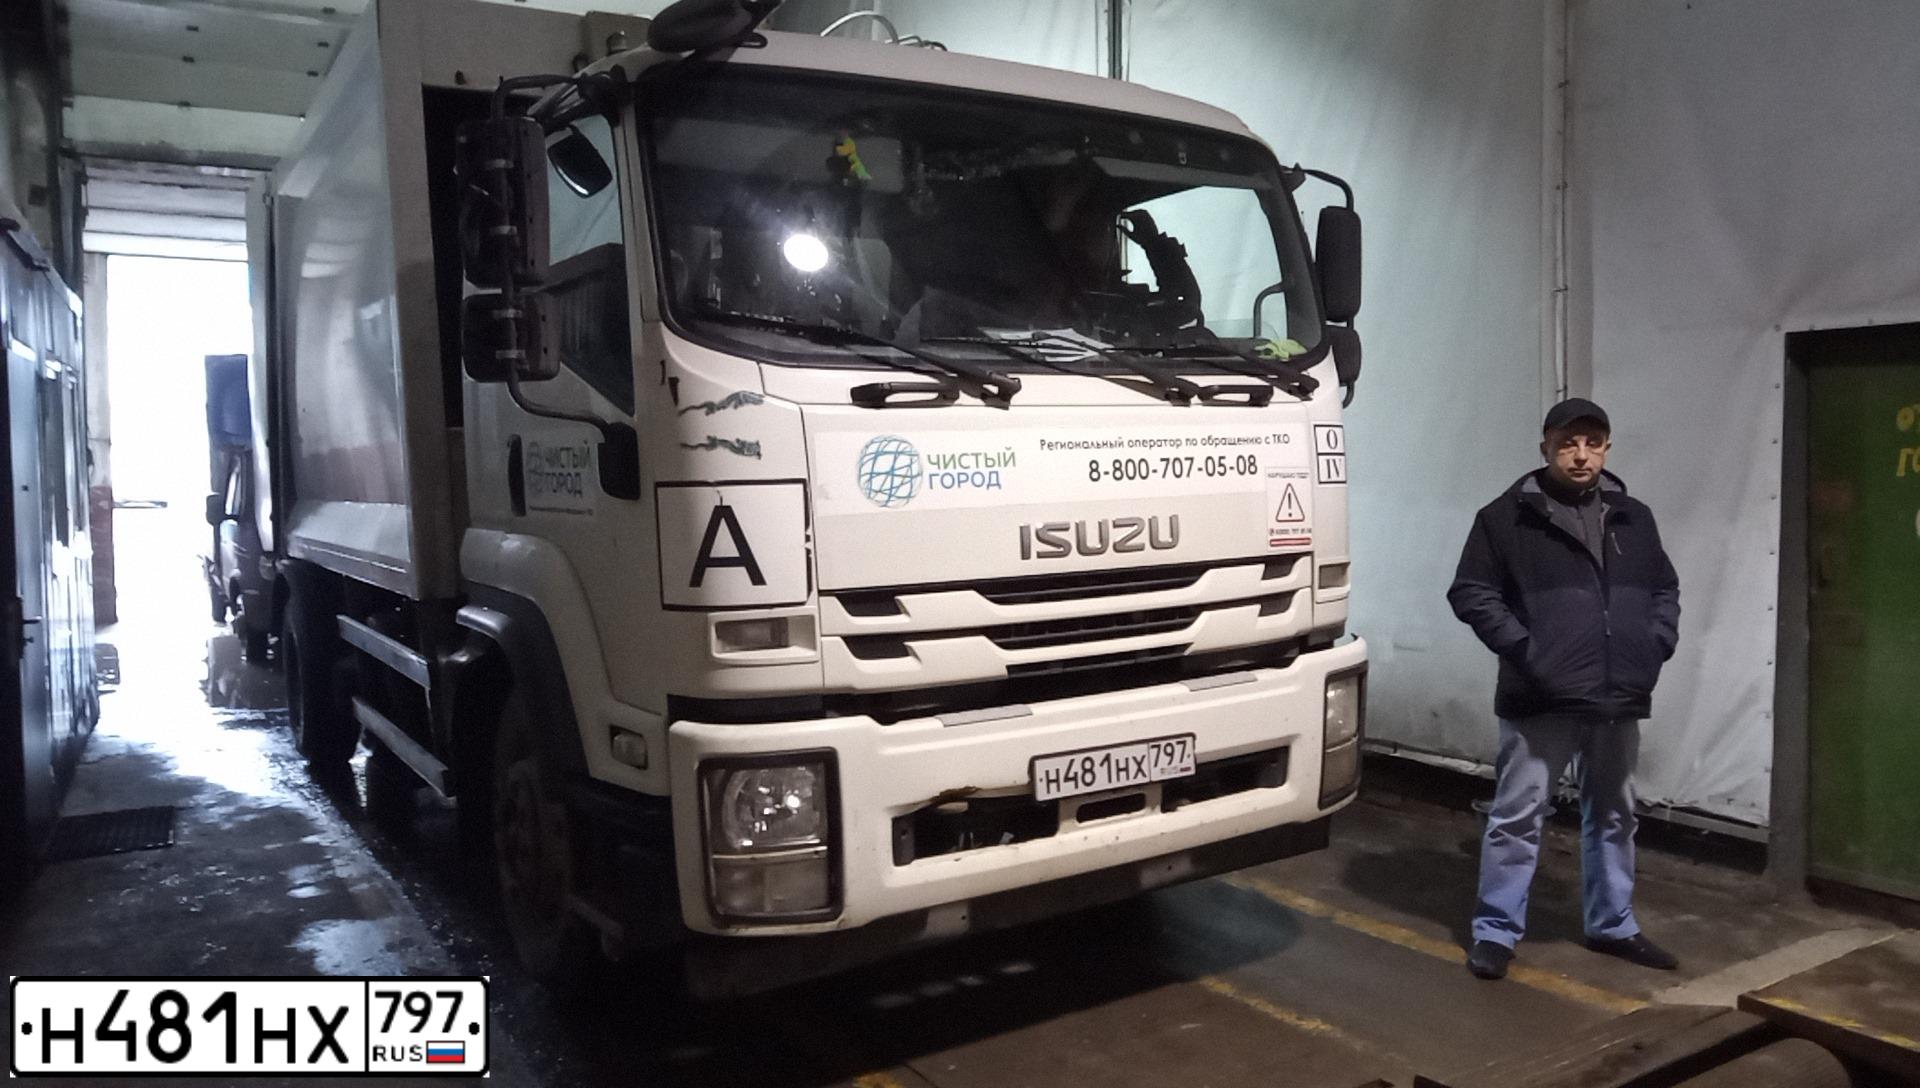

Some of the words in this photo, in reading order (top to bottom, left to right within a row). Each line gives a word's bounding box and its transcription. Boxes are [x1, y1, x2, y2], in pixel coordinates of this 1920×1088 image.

[1040, 436, 1125, 451] Региональный
[1127, 438, 1182, 450] оператор
[1185, 438, 1198, 447] по
[1200, 435, 1262, 448] обращению
[1264, 436, 1271, 445] с
[1272, 433, 1290, 444] ТКО
[927, 446, 1016, 470] ЧИСТЫЙ
[1089, 454, 1258, 482] 8-800-707-05-08
[928, 471, 1002, 490] ГОРОД
[689, 504, 768, 588] A
[1019, 514, 1180, 560] ISUZU
[1045, 753, 1148, 795] Н481НХ
[1151, 740, 1187, 768] 797
